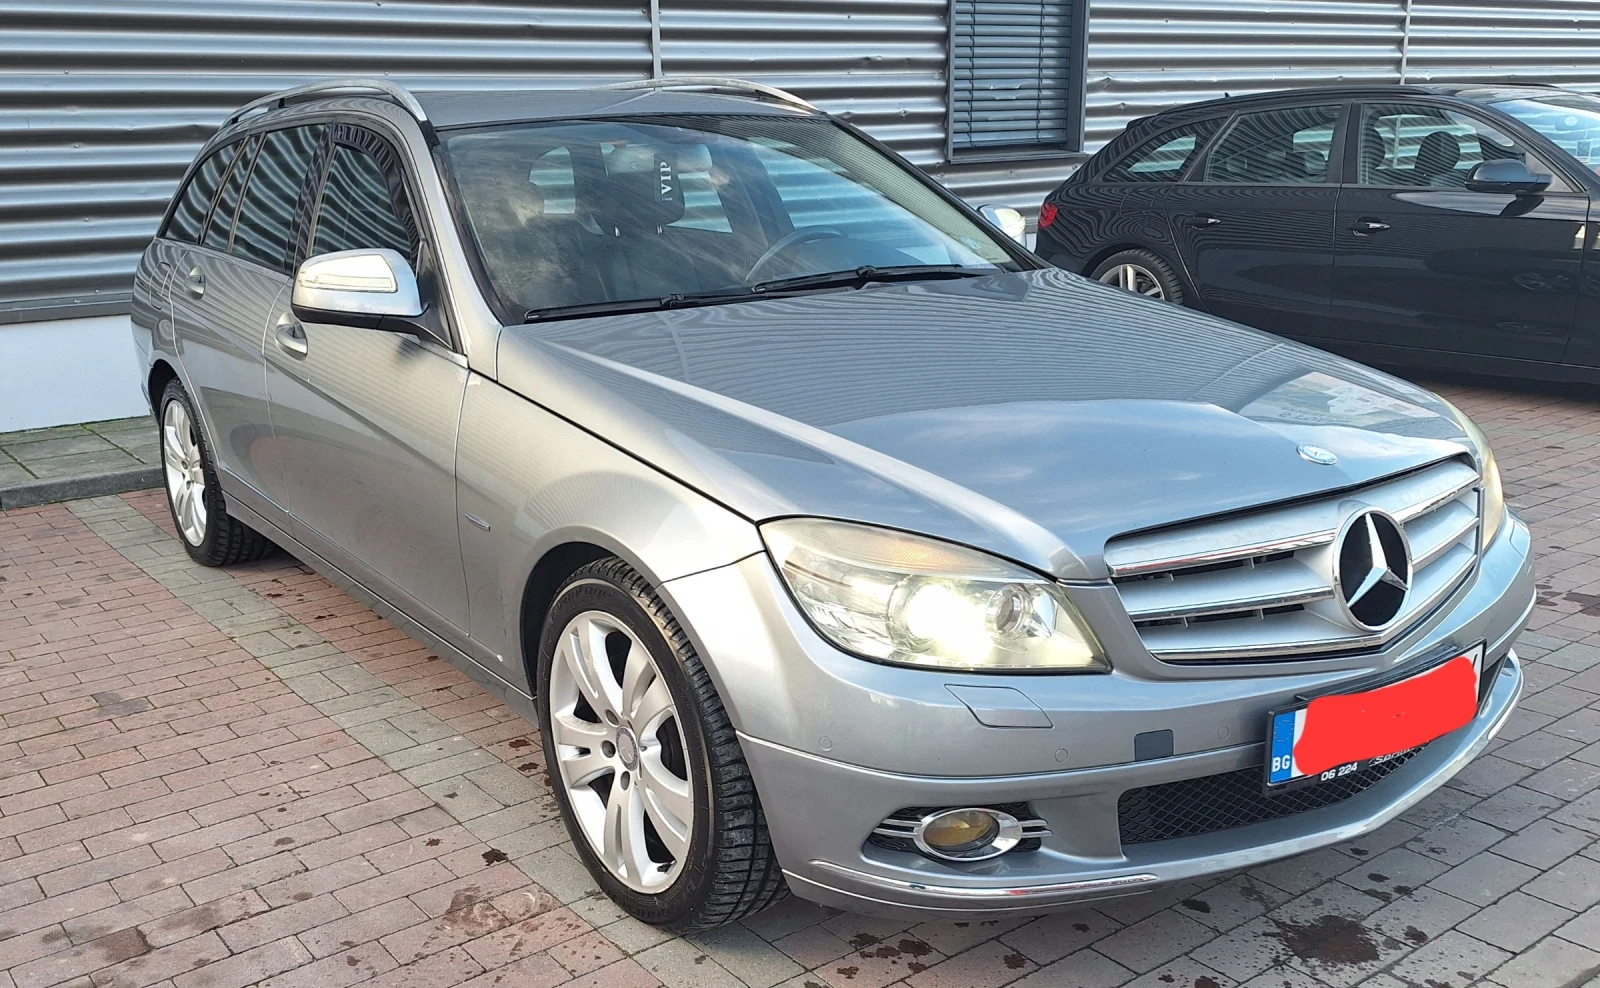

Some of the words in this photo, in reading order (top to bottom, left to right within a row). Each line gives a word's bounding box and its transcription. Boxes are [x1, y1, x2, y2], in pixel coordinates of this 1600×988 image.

[660, 161, 672, 195] VIP
[1271, 754, 1291, 772] BG
[1320, 769, 1336, 782] 06
[1338, 762, 1358, 776] 224
